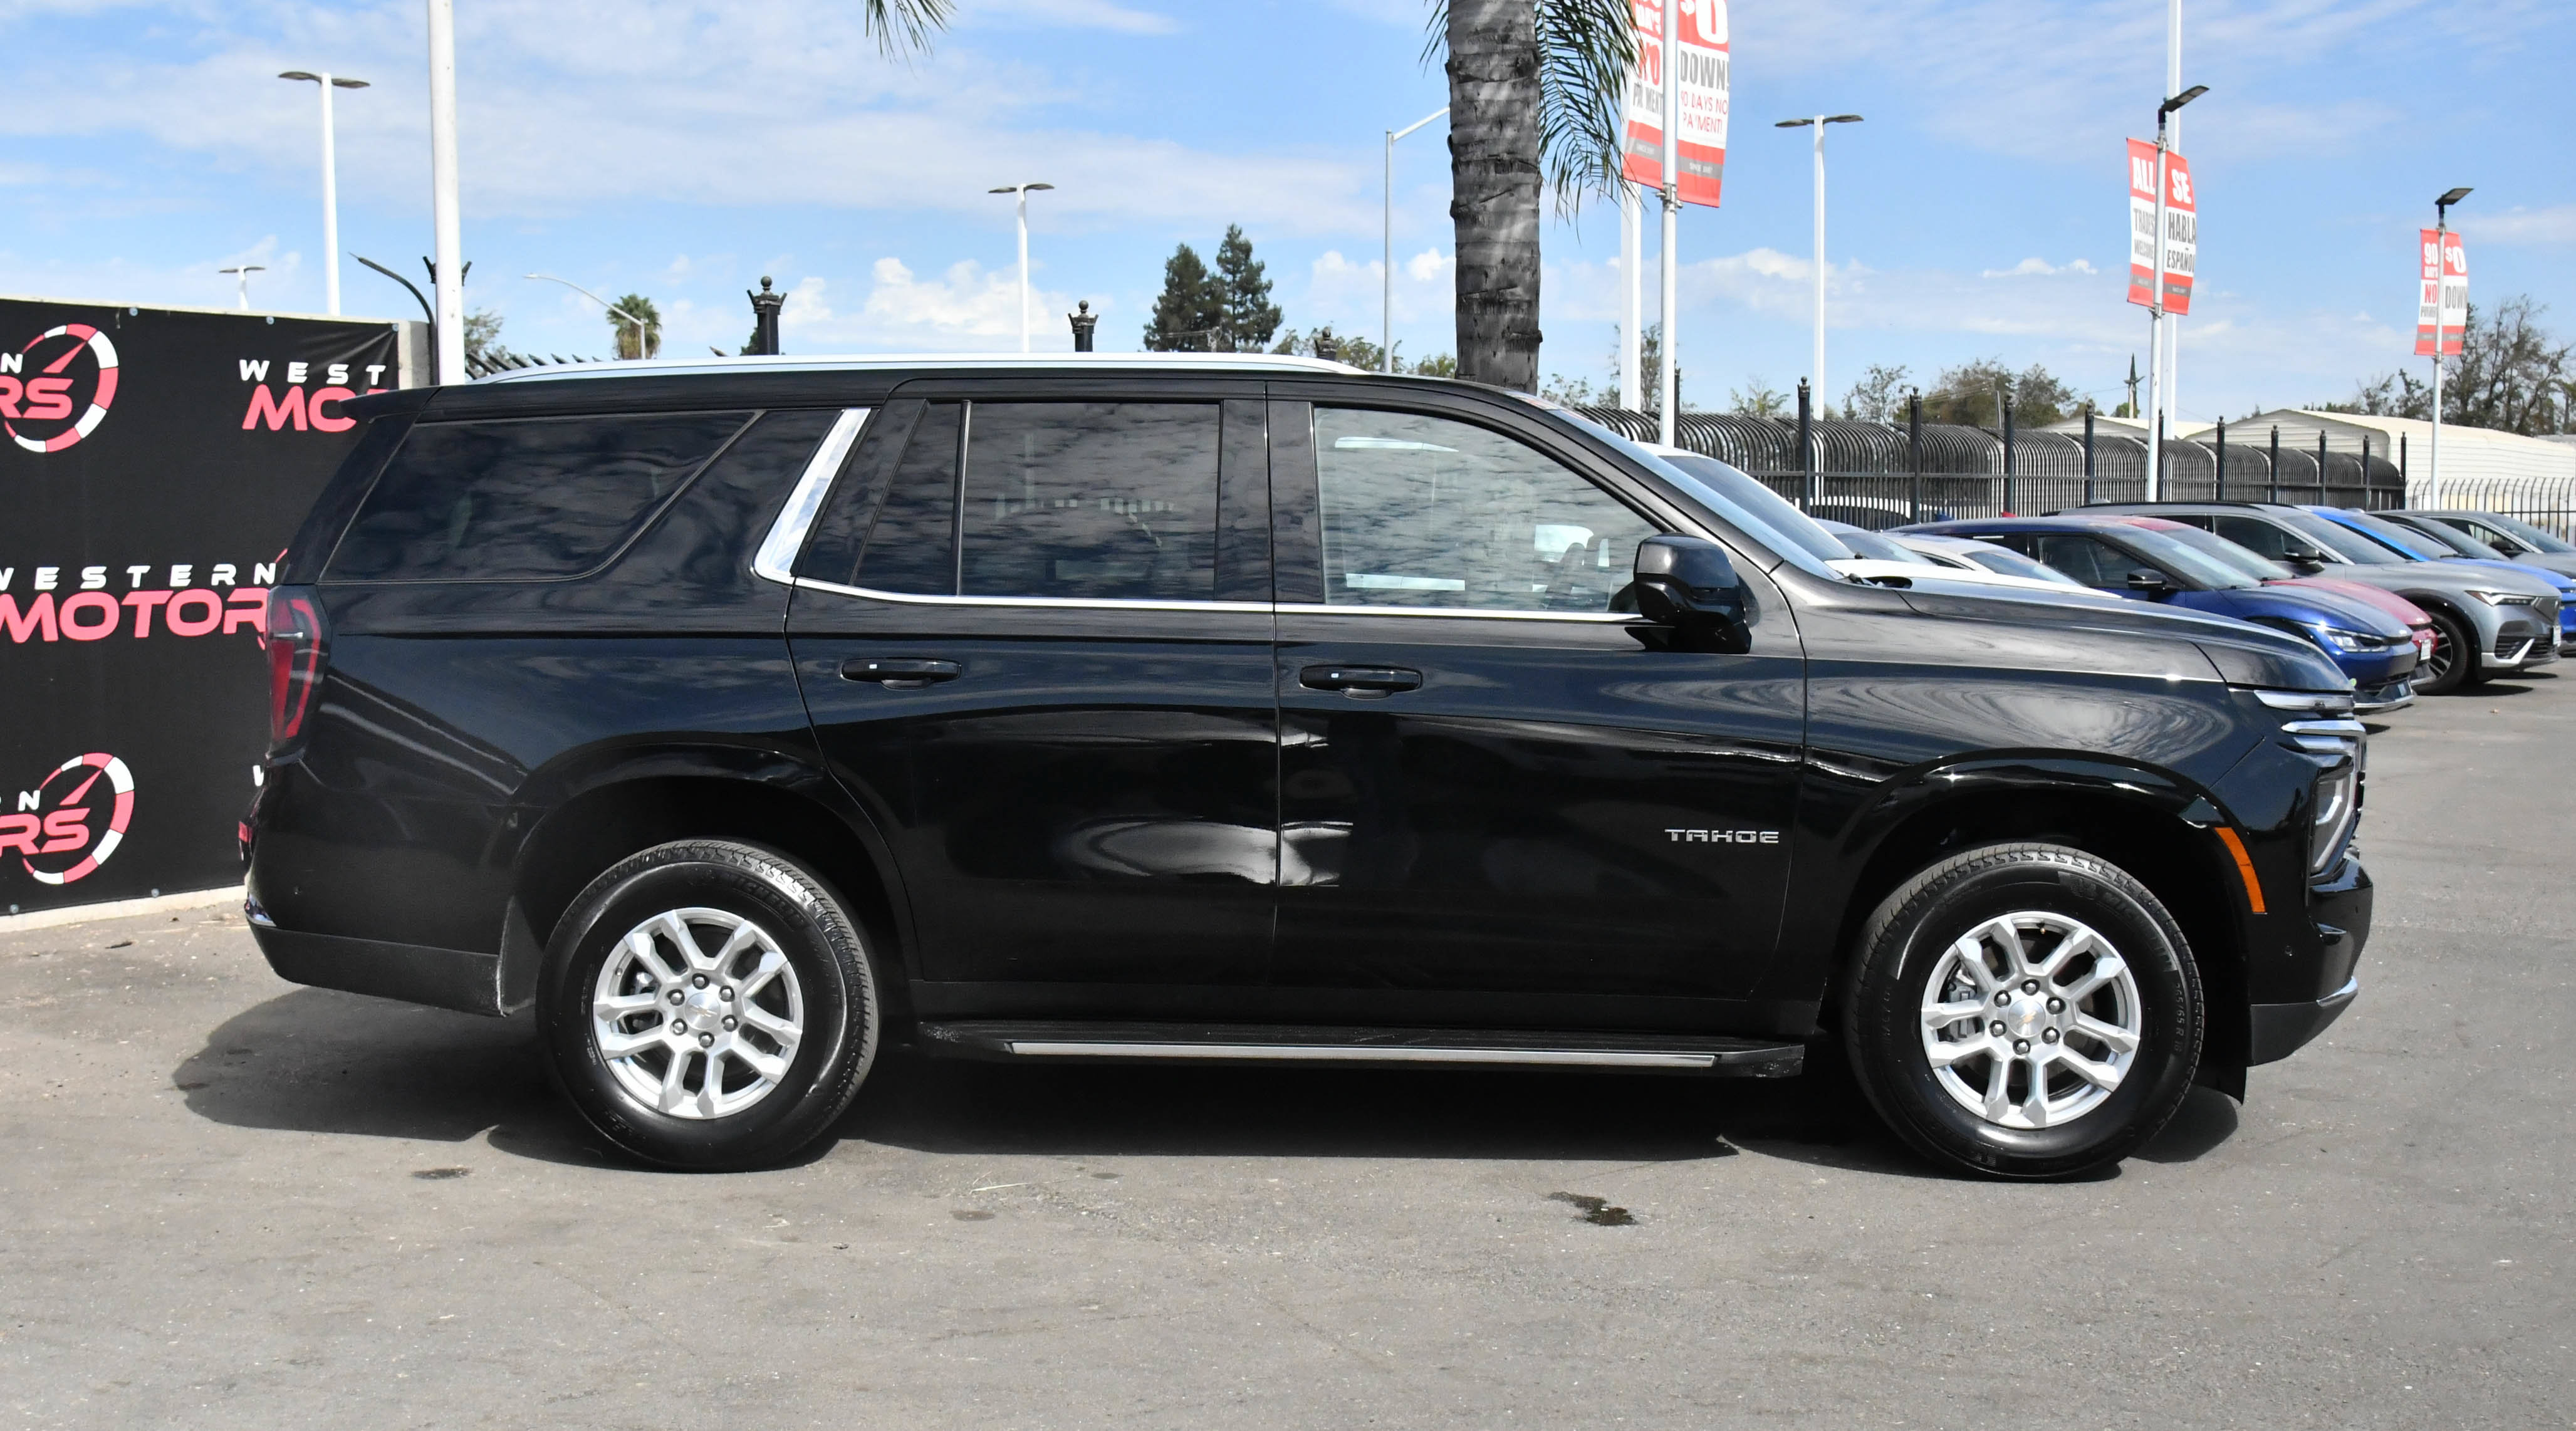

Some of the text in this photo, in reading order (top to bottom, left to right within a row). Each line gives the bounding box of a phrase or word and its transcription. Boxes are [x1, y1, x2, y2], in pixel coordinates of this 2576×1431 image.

[1691, 92, 1713, 112] DAYS
[1716, 98, 1728, 115] NO
[2132, 157, 2156, 195] ALL
[2171, 169, 2192, 204] SE
[2424, 242, 2438, 265] 90
[2445, 246, 2467, 273] $0
[2424, 284, 2437, 304] NO
[239, 359, 387, 386] WEST
[242, 383, 389, 432] MO
[0, 808, 91, 858] RS
[1664, 828, 1780, 844] TAHOE
